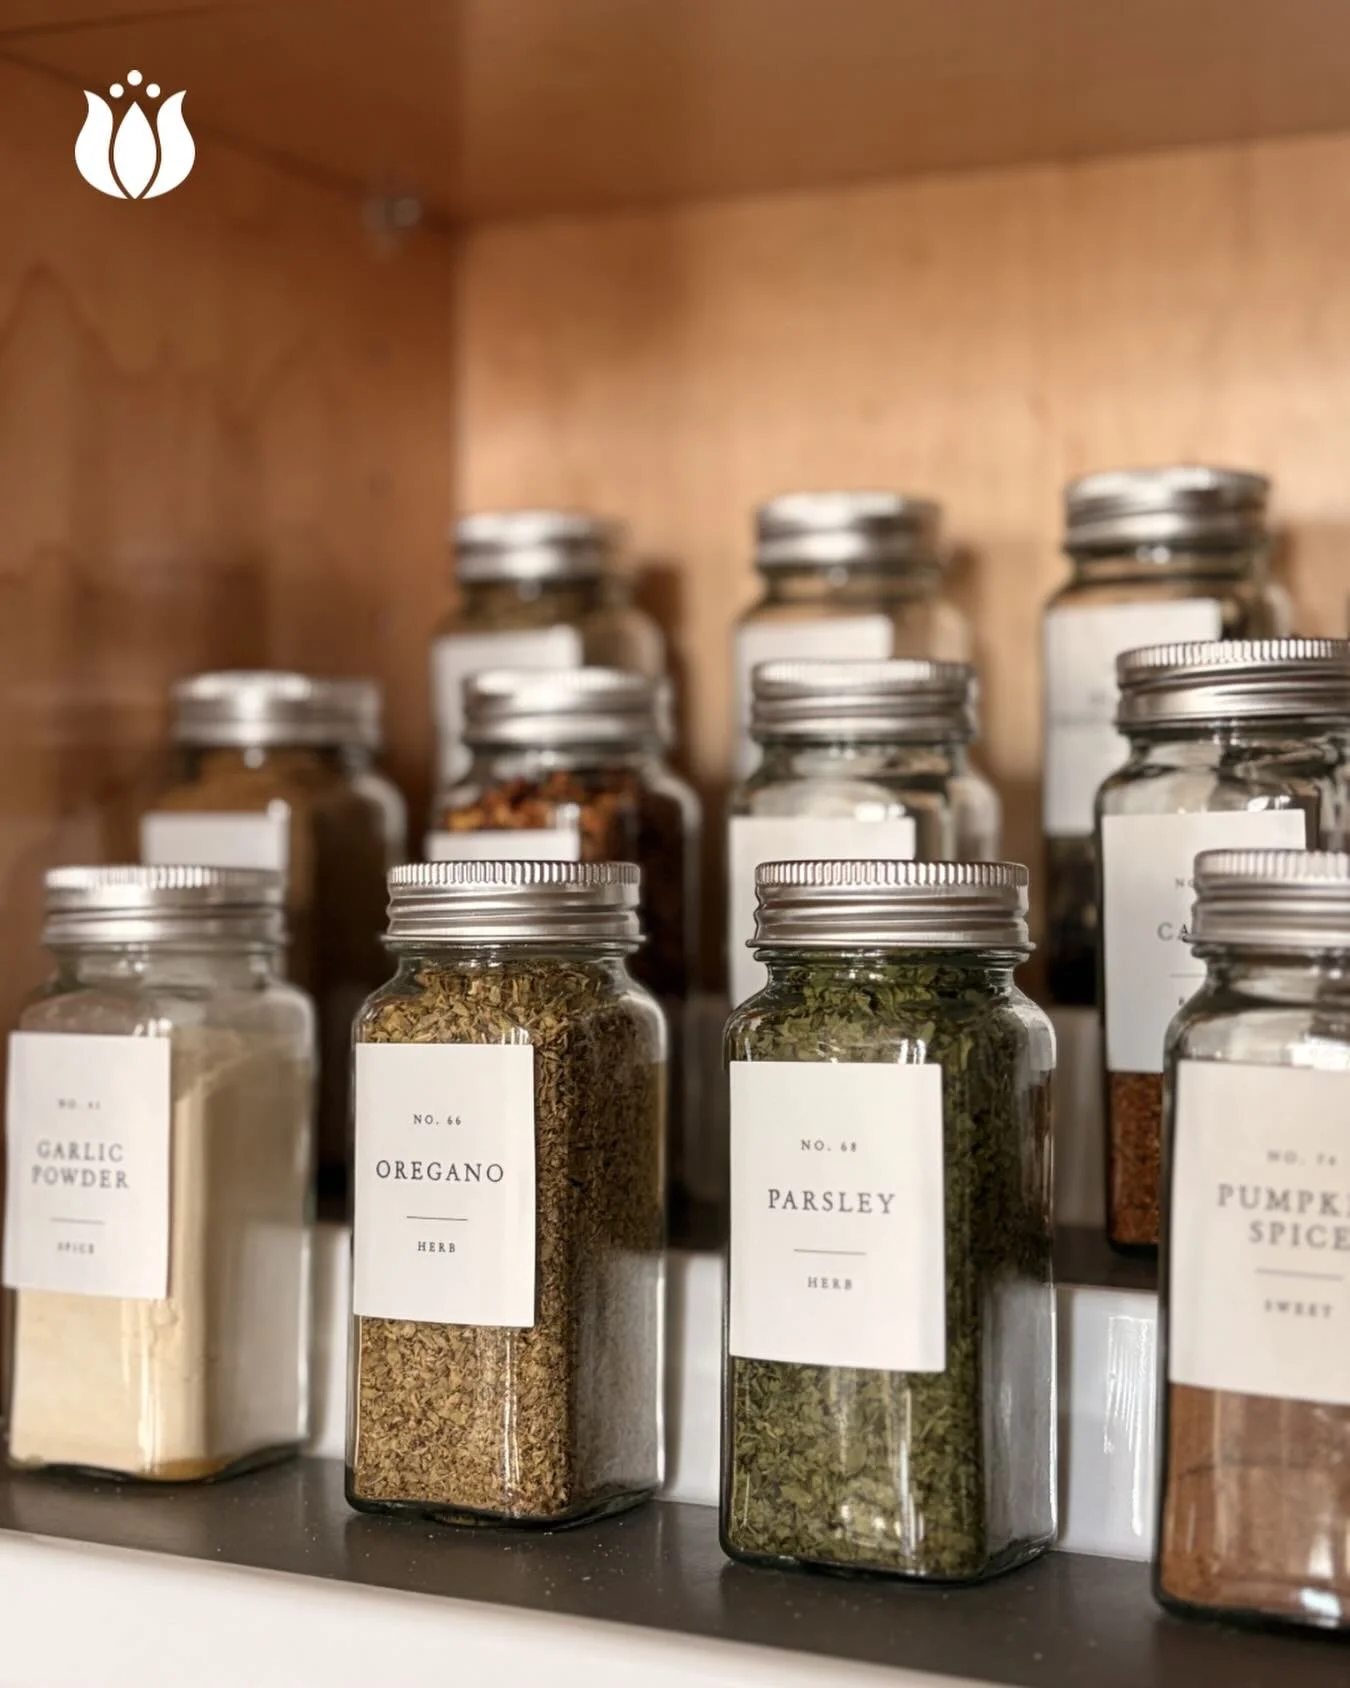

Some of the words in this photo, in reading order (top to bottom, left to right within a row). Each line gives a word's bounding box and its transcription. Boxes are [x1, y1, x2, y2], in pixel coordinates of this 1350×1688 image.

[413, 1114, 439, 1125] NO.
[447, 1115, 461, 1126] 66
[36, 1139, 124, 1163] GARLIC
[801, 1139, 831, 1151] NO.
[31, 1164, 129, 1189] POWDER
[375, 1160, 504, 1183] OREGANO
[768, 1188, 896, 1214] PARSLEY
[417, 1241, 456, 1253] HERB
[1249, 1220, 1350, 1251] SPICE
[807, 1275, 852, 1290] HERB
